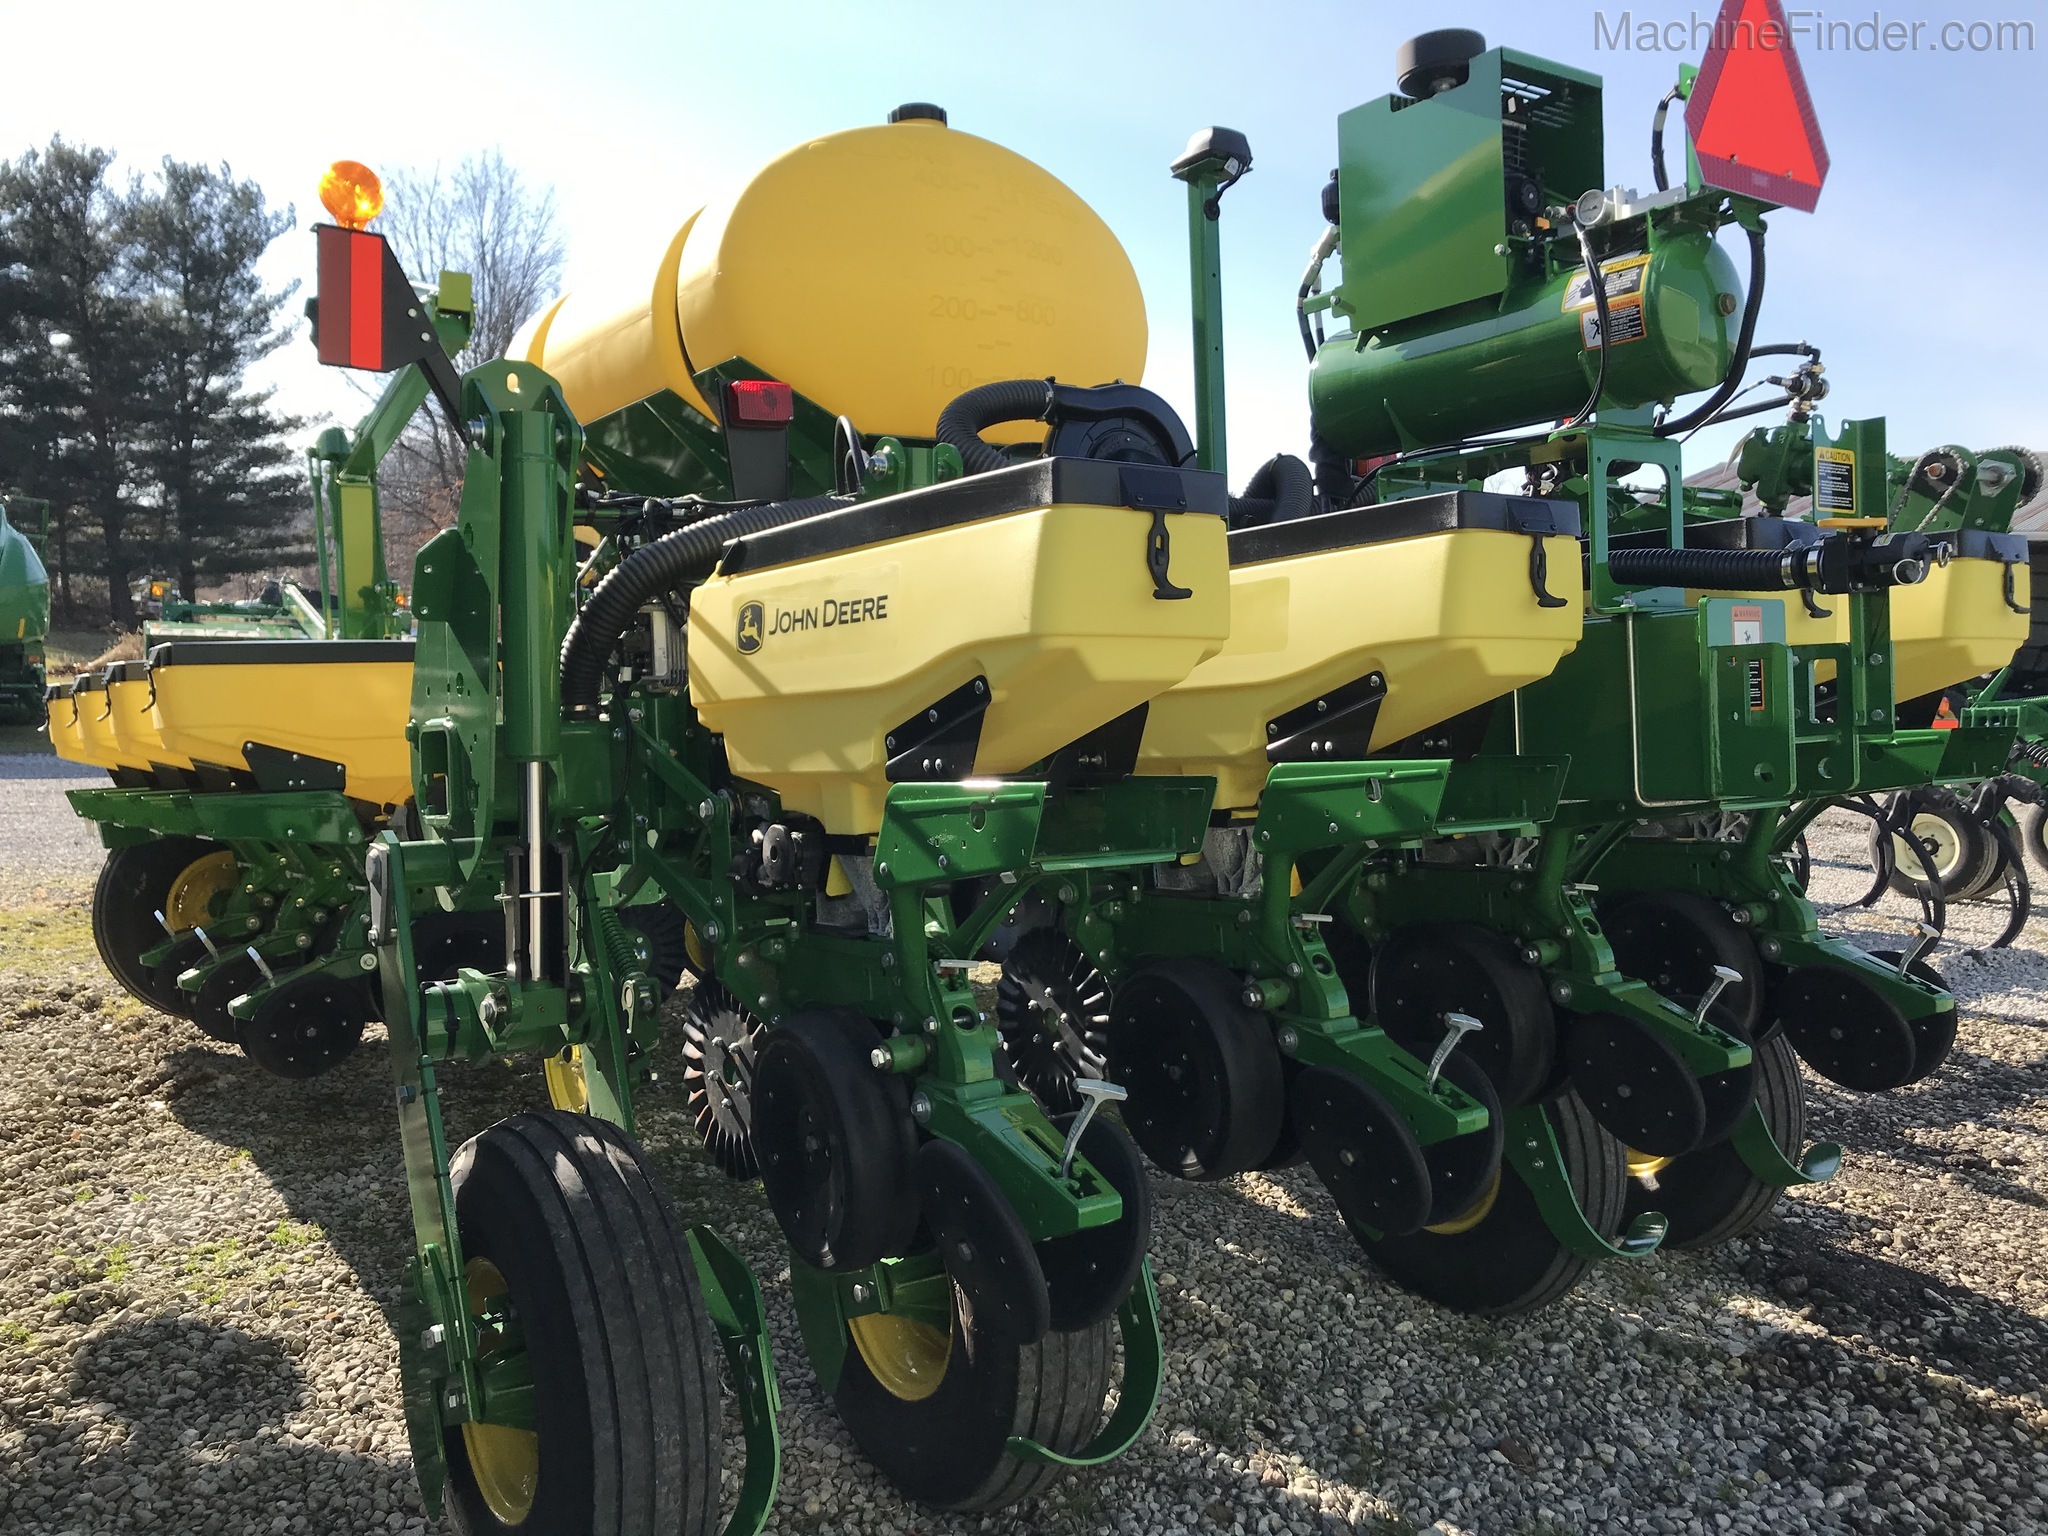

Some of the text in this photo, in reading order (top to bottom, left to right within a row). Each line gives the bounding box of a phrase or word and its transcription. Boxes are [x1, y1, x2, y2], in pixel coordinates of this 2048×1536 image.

[925, 232, 975, 258] 300
[1613, 255, 1649, 269] CAUTION
[928, 294, 977, 321] 200
[1610, 298, 1640, 309] WARNING
[925, 365, 973, 389] 100
[1825, 451, 1851, 462] CAUTION
[768, 594, 889, 636] JOHN DEERE
[1738, 610, 1760, 618] WARNING
